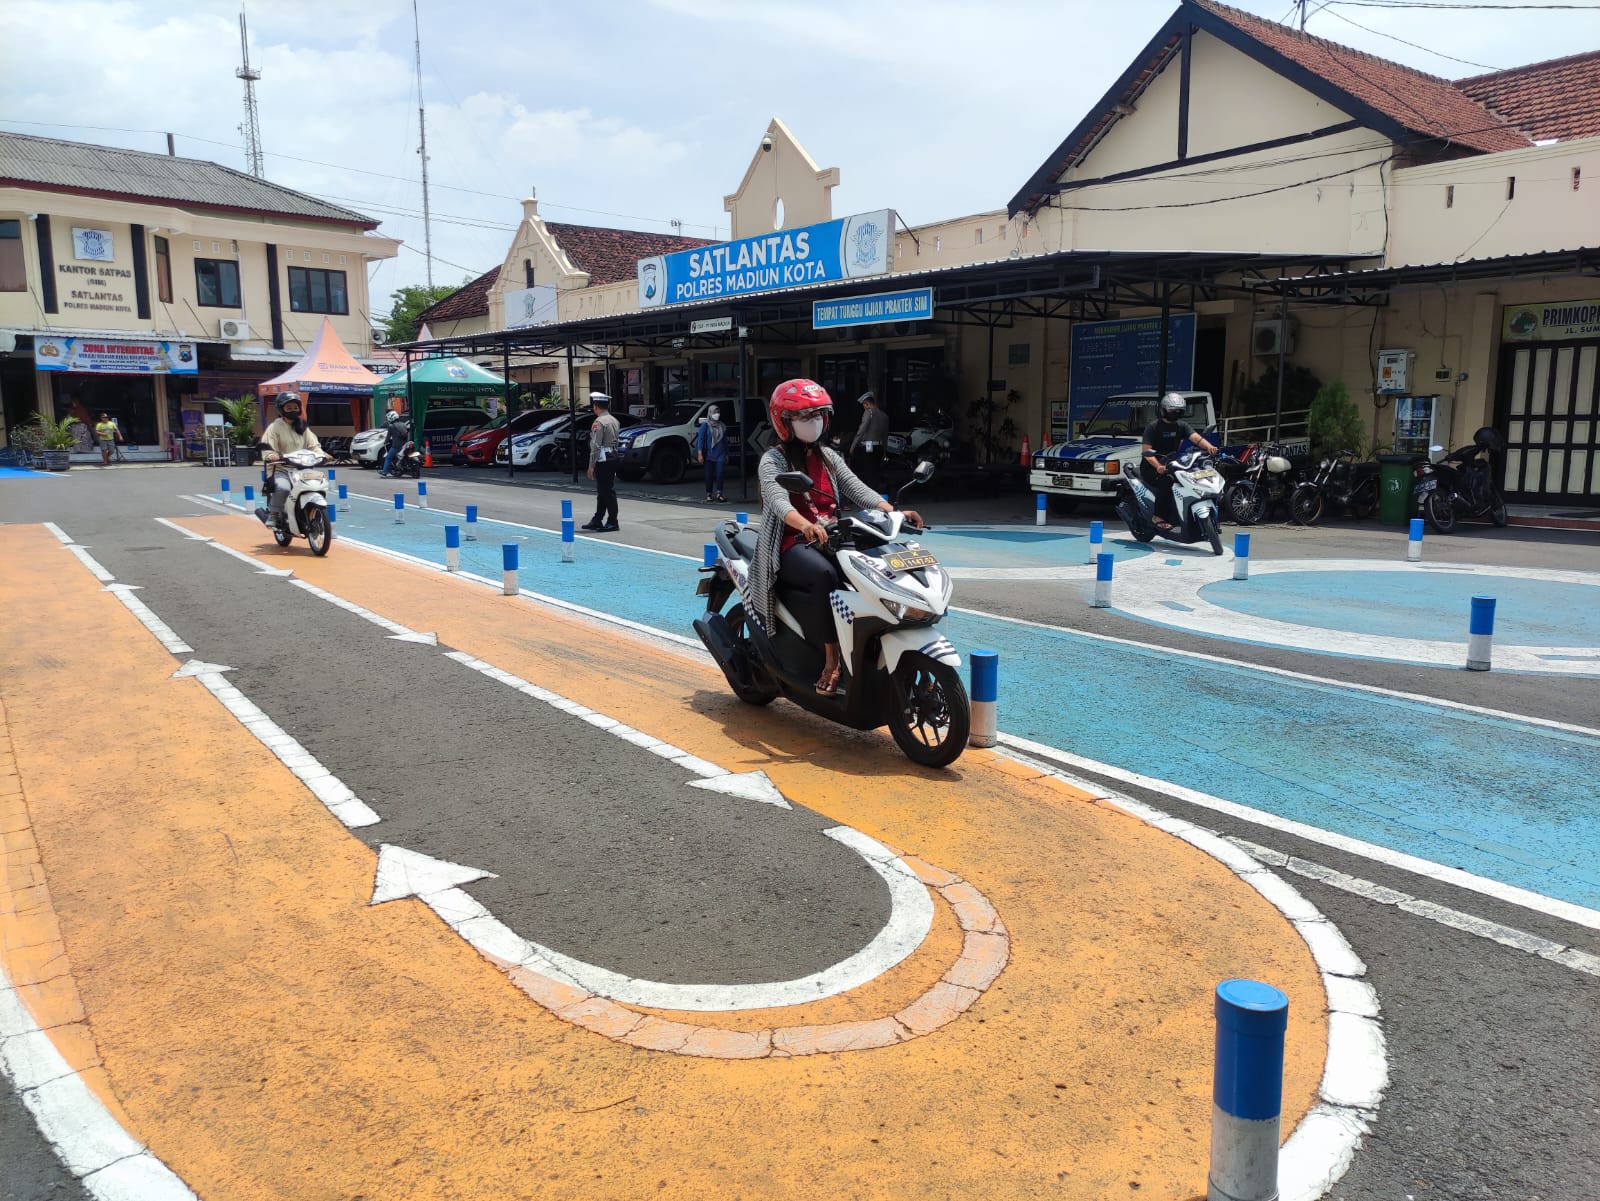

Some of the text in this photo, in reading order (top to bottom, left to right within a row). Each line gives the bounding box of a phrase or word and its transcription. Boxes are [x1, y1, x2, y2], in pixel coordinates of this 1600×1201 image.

[689, 231, 810, 278] SATLANTAS
[59, 264, 131, 278] KANTOR SATPAS
[676, 260, 826, 299] POLRES MADIUN KOTA
[71, 290, 123, 302] SATLANTAS
[64, 302, 88, 310] POLRES
[817, 295, 928, 321] TEMPAT TUNGGU UJIAN PRAKTEK SIM
[83, 343, 155, 355] ZONA INTEGRITAS
